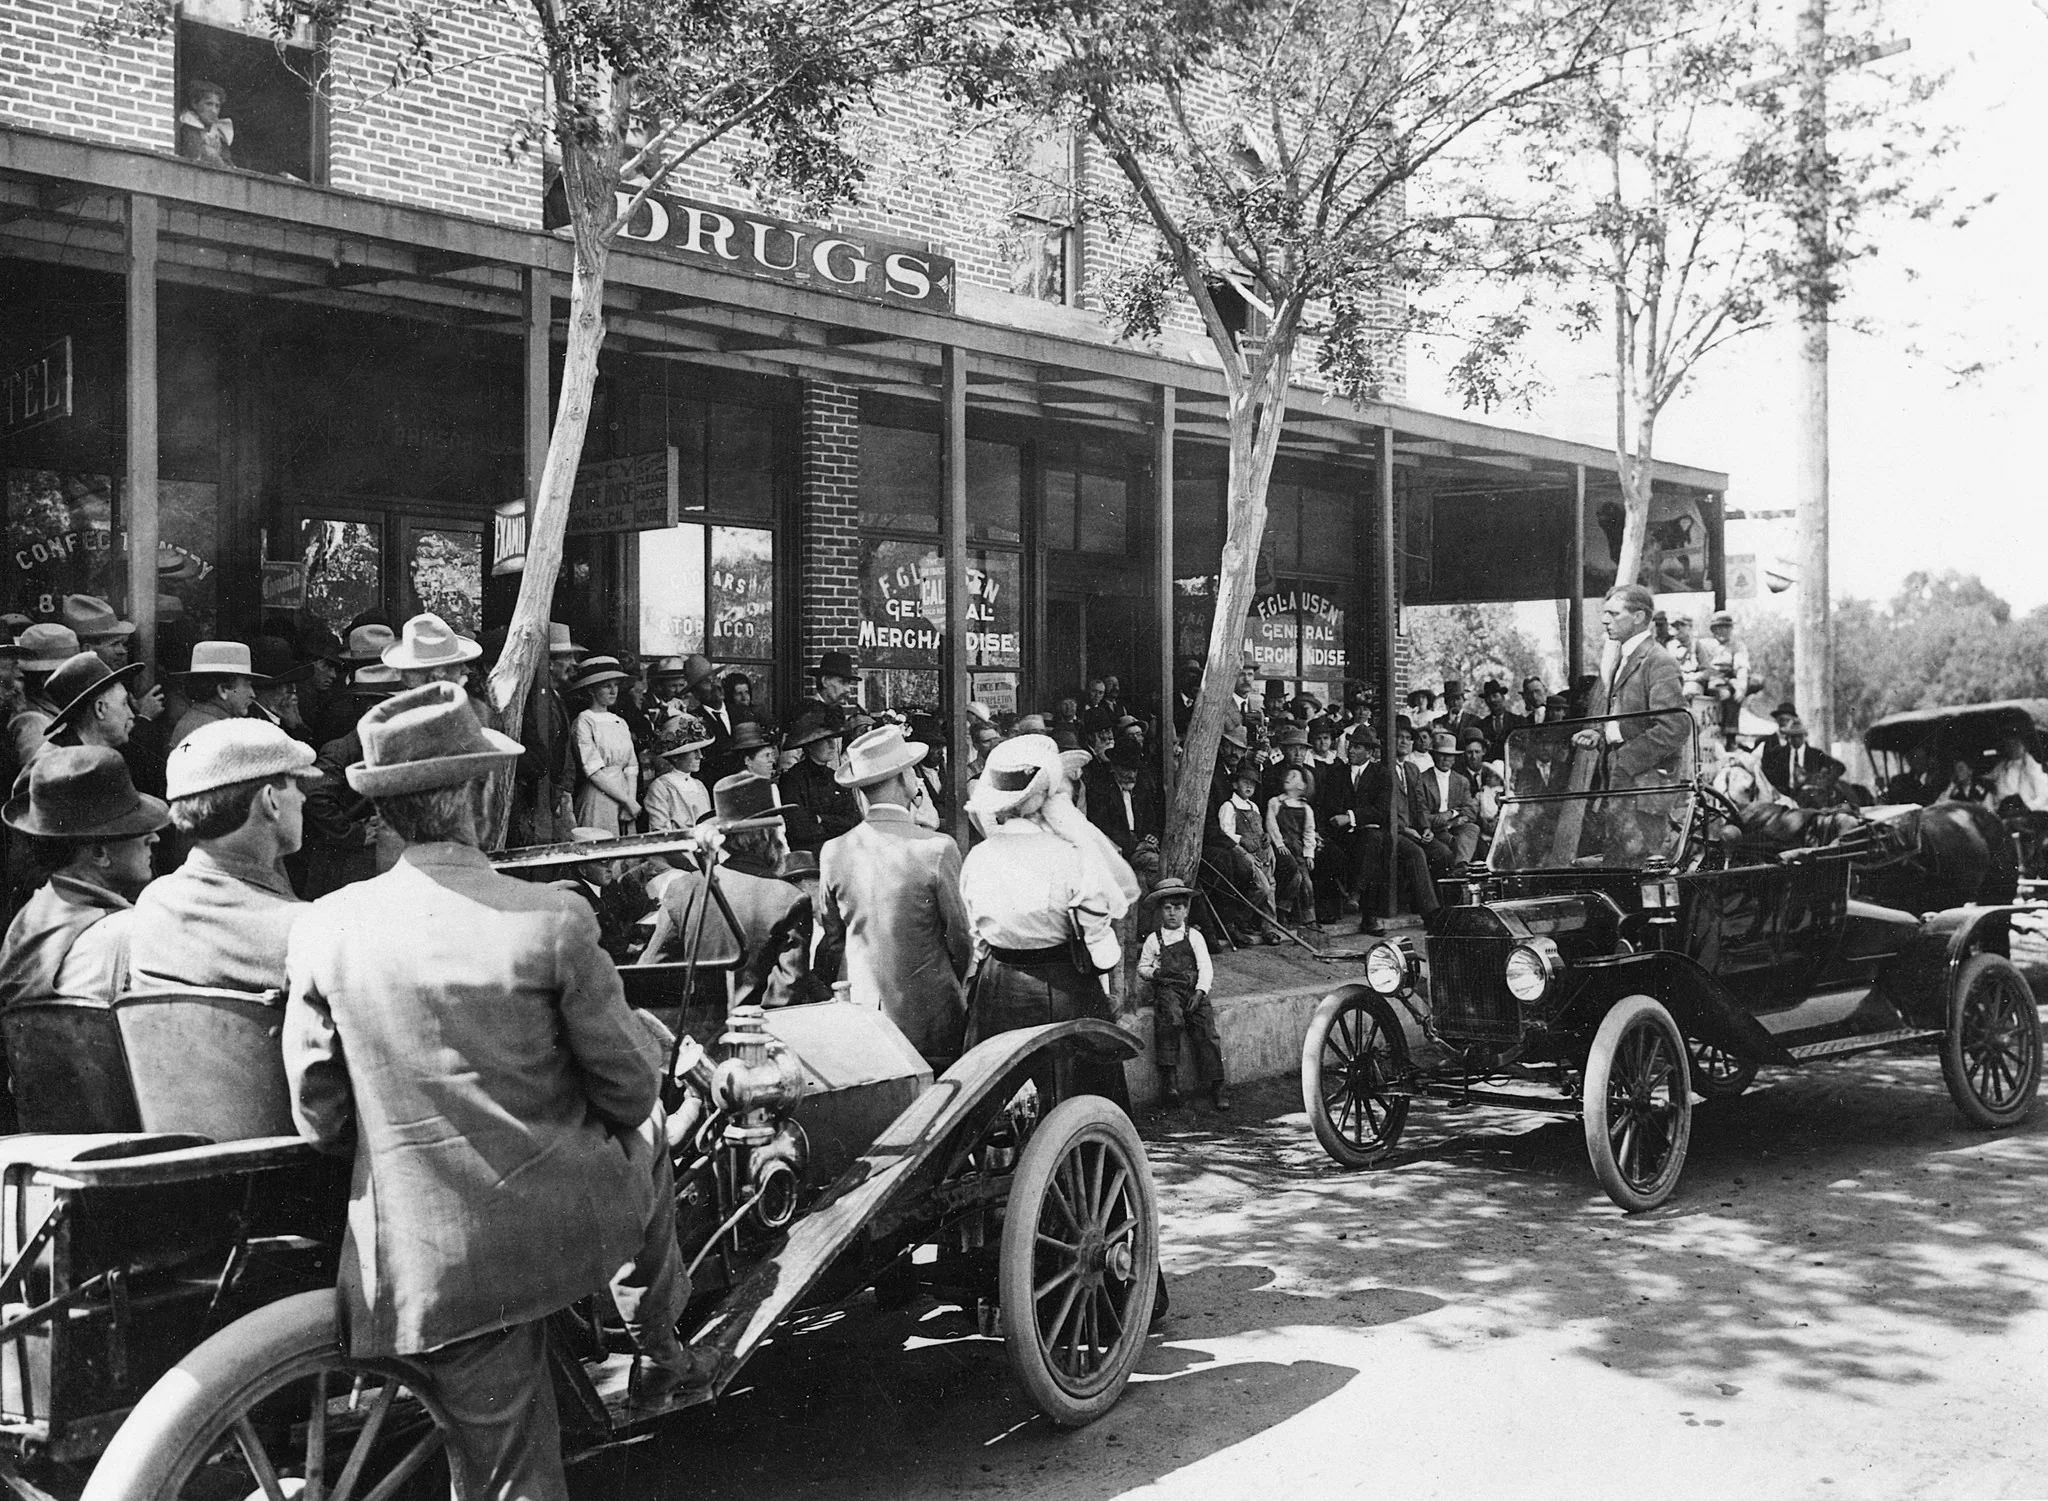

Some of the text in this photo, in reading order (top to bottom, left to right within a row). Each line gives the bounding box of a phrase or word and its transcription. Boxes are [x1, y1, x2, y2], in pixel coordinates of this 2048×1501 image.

[615, 191, 932, 300] DRUGS
[1, 357, 61, 425] TEL
[493, 515, 526, 566] EXAMI
[885, 599, 995, 622] GEAL
[922, 579, 946, 605] CAL
[672, 618, 756, 638] TOBACCO
